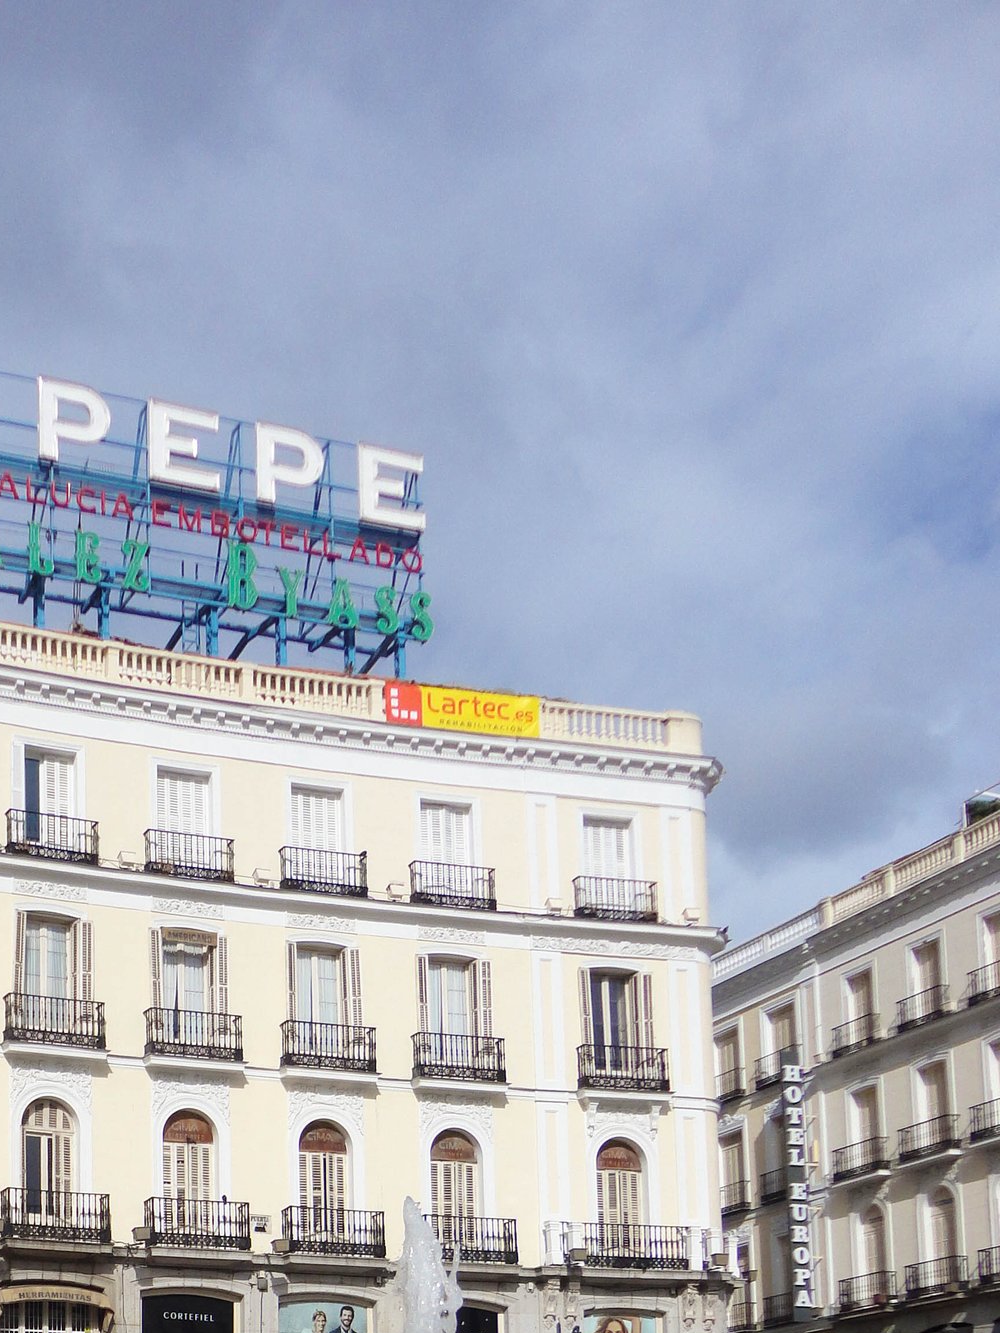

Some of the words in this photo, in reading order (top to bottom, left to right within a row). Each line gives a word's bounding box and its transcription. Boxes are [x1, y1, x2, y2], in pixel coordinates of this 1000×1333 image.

[37, 375, 427, 533] PEPE
[152, 500, 424, 573] EMBOTELLADO
[226, 538, 434, 643] BYASS
[782, 1065, 806, 1167] HOTEL
[18, 1291, 92, 1302] HERRAMIENTAS
[789, 1183, 813, 1308] EUROPA
[163, 1311, 215, 1322] CORTEFIEL
